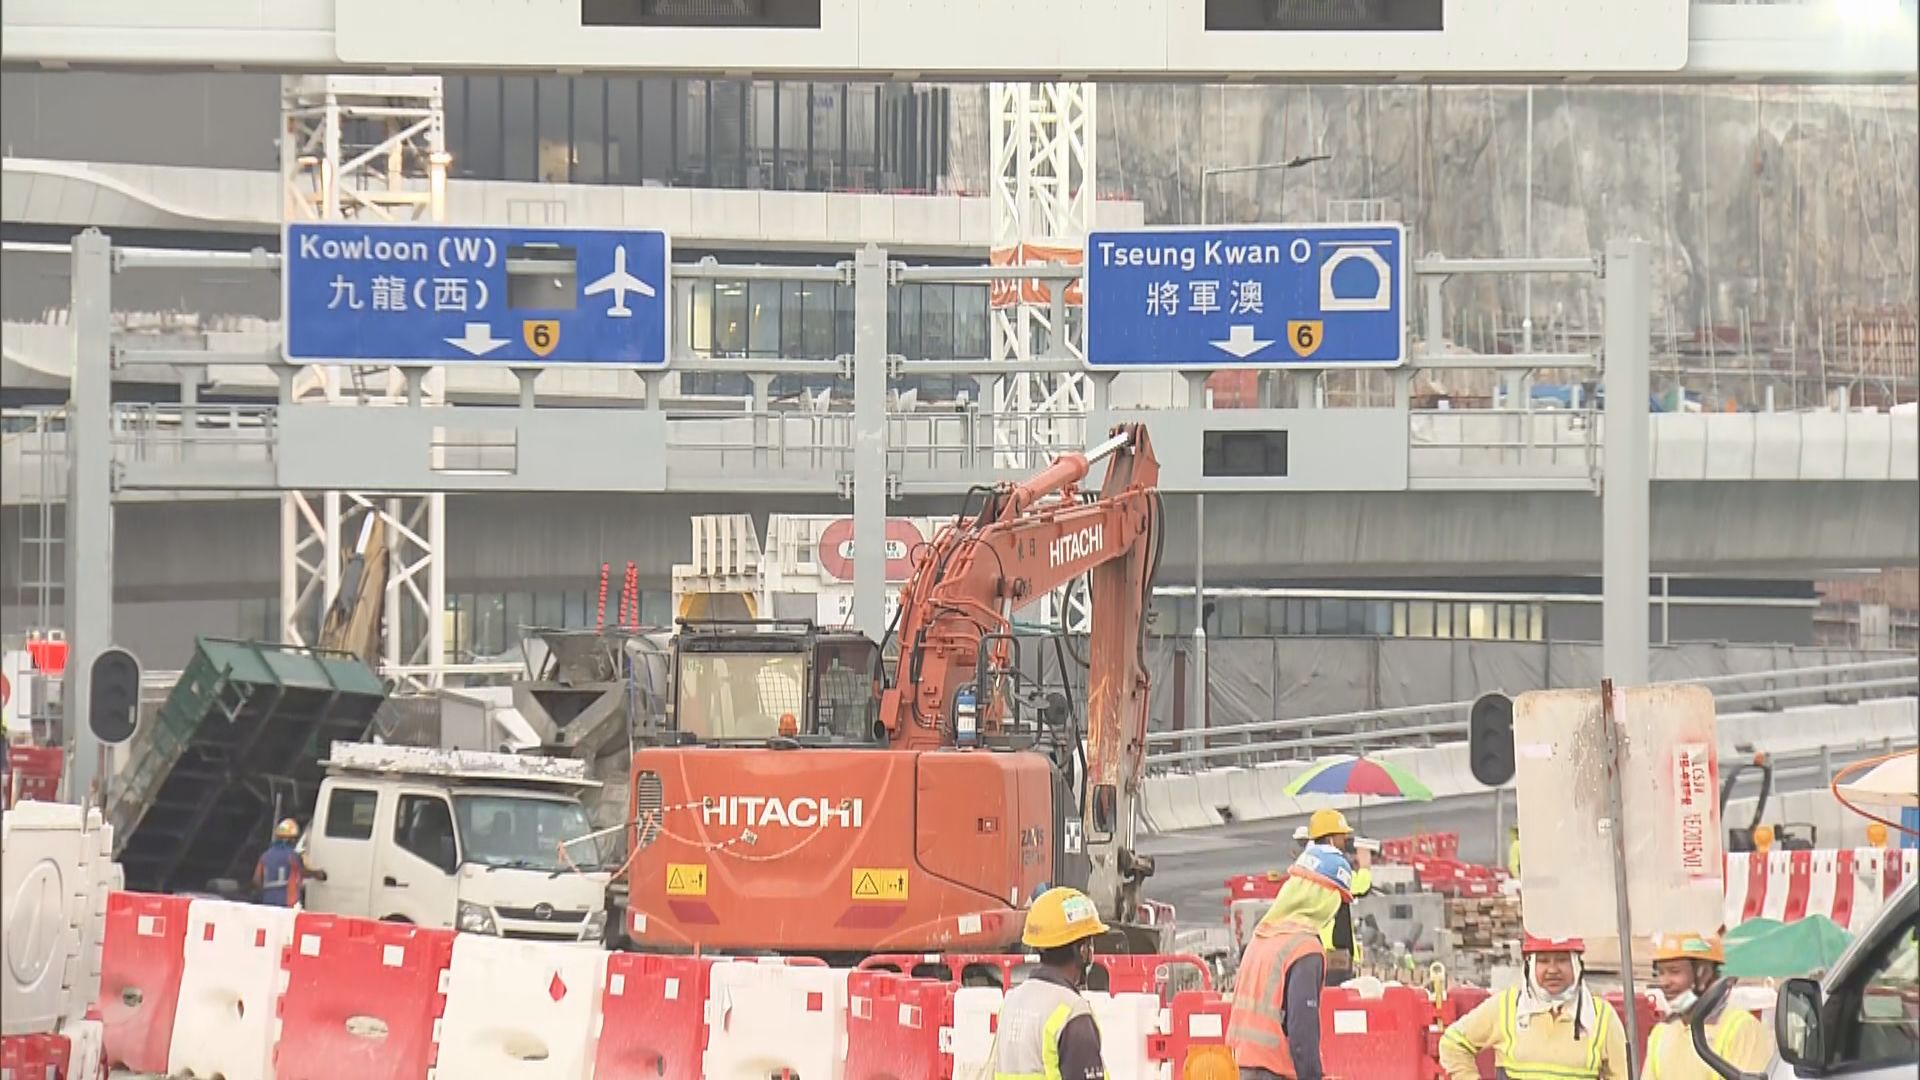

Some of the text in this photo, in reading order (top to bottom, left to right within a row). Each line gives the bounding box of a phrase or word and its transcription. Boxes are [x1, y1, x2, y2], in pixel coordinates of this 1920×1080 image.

[299, 233, 498, 268] Kowloon (W)
[1098, 237, 1312, 271] Tseung Kwan O
[327, 273, 490, 312] 九龍(西)
[1145, 278, 1265, 317] 將軍澳
[533, 324, 550, 347] 6
[1296, 325, 1313, 348] 6
[1048, 522, 1103, 569] HITACHI
[702, 794, 863, 828] HITACHI
